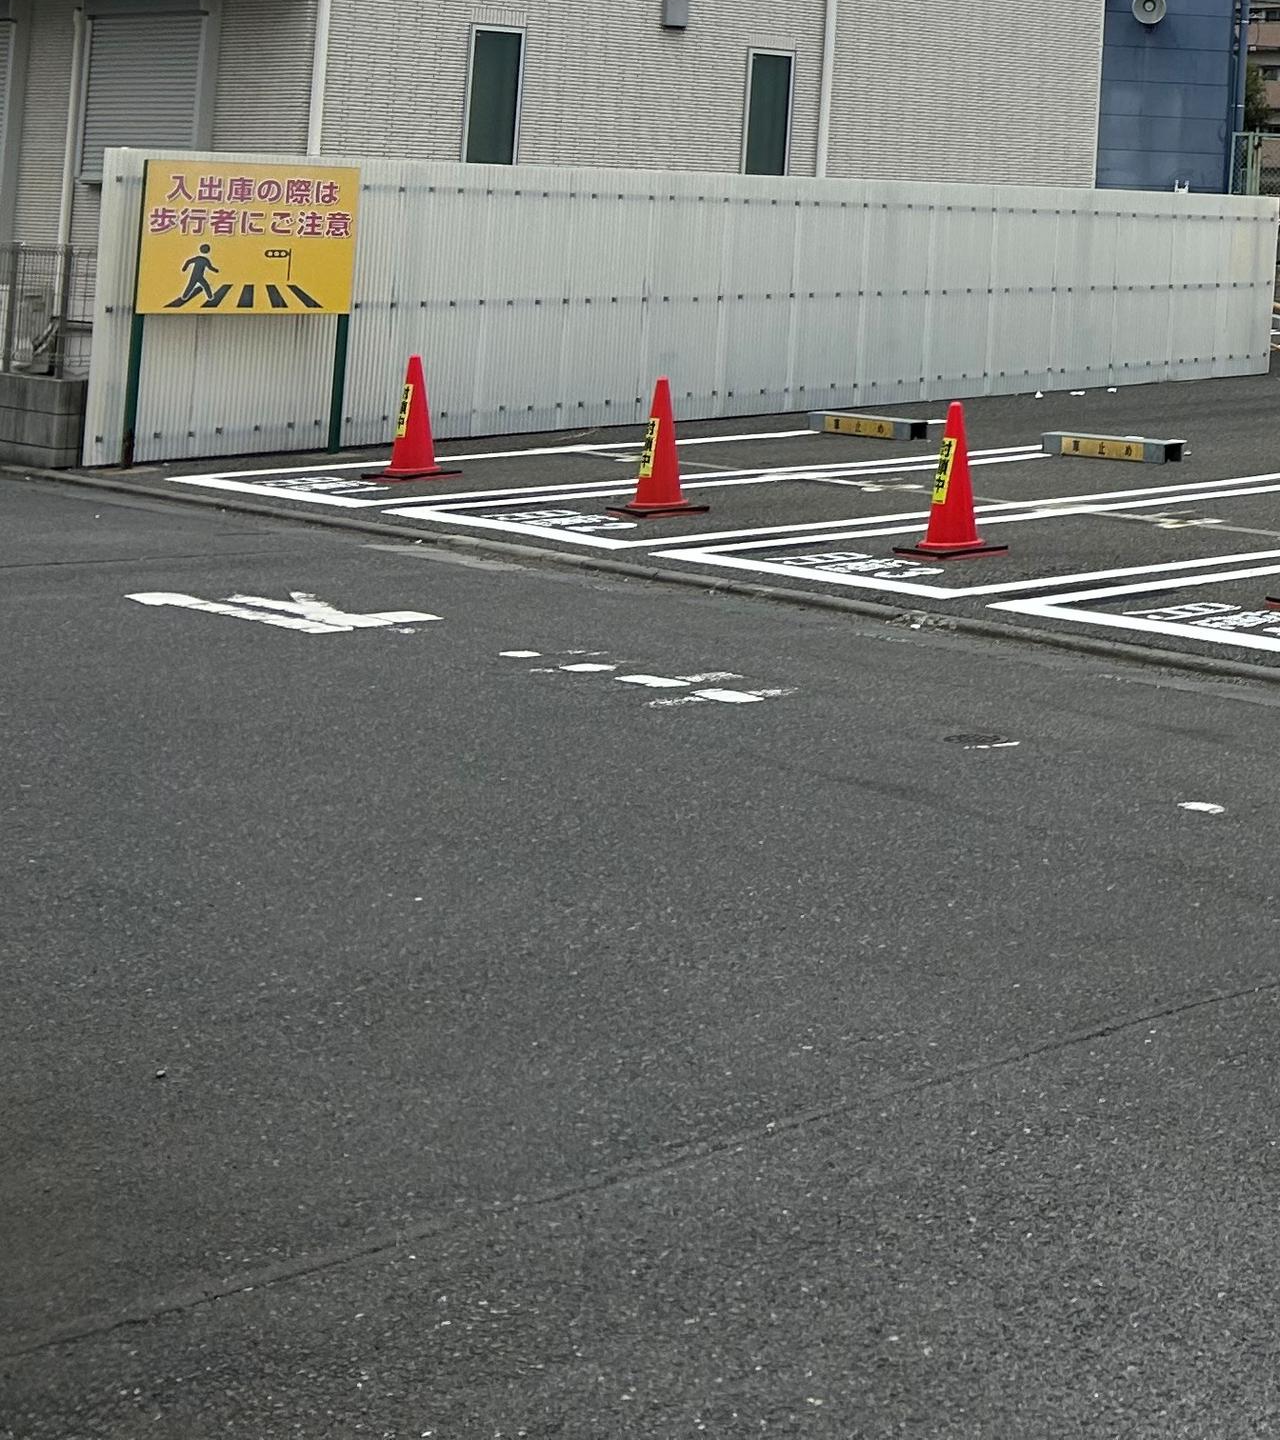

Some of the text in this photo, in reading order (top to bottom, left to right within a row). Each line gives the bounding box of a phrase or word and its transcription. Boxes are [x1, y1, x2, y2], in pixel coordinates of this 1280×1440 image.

[166, 174, 339, 204] 入出庫の際は
[149, 207, 352, 237] 歩行者にご注意
